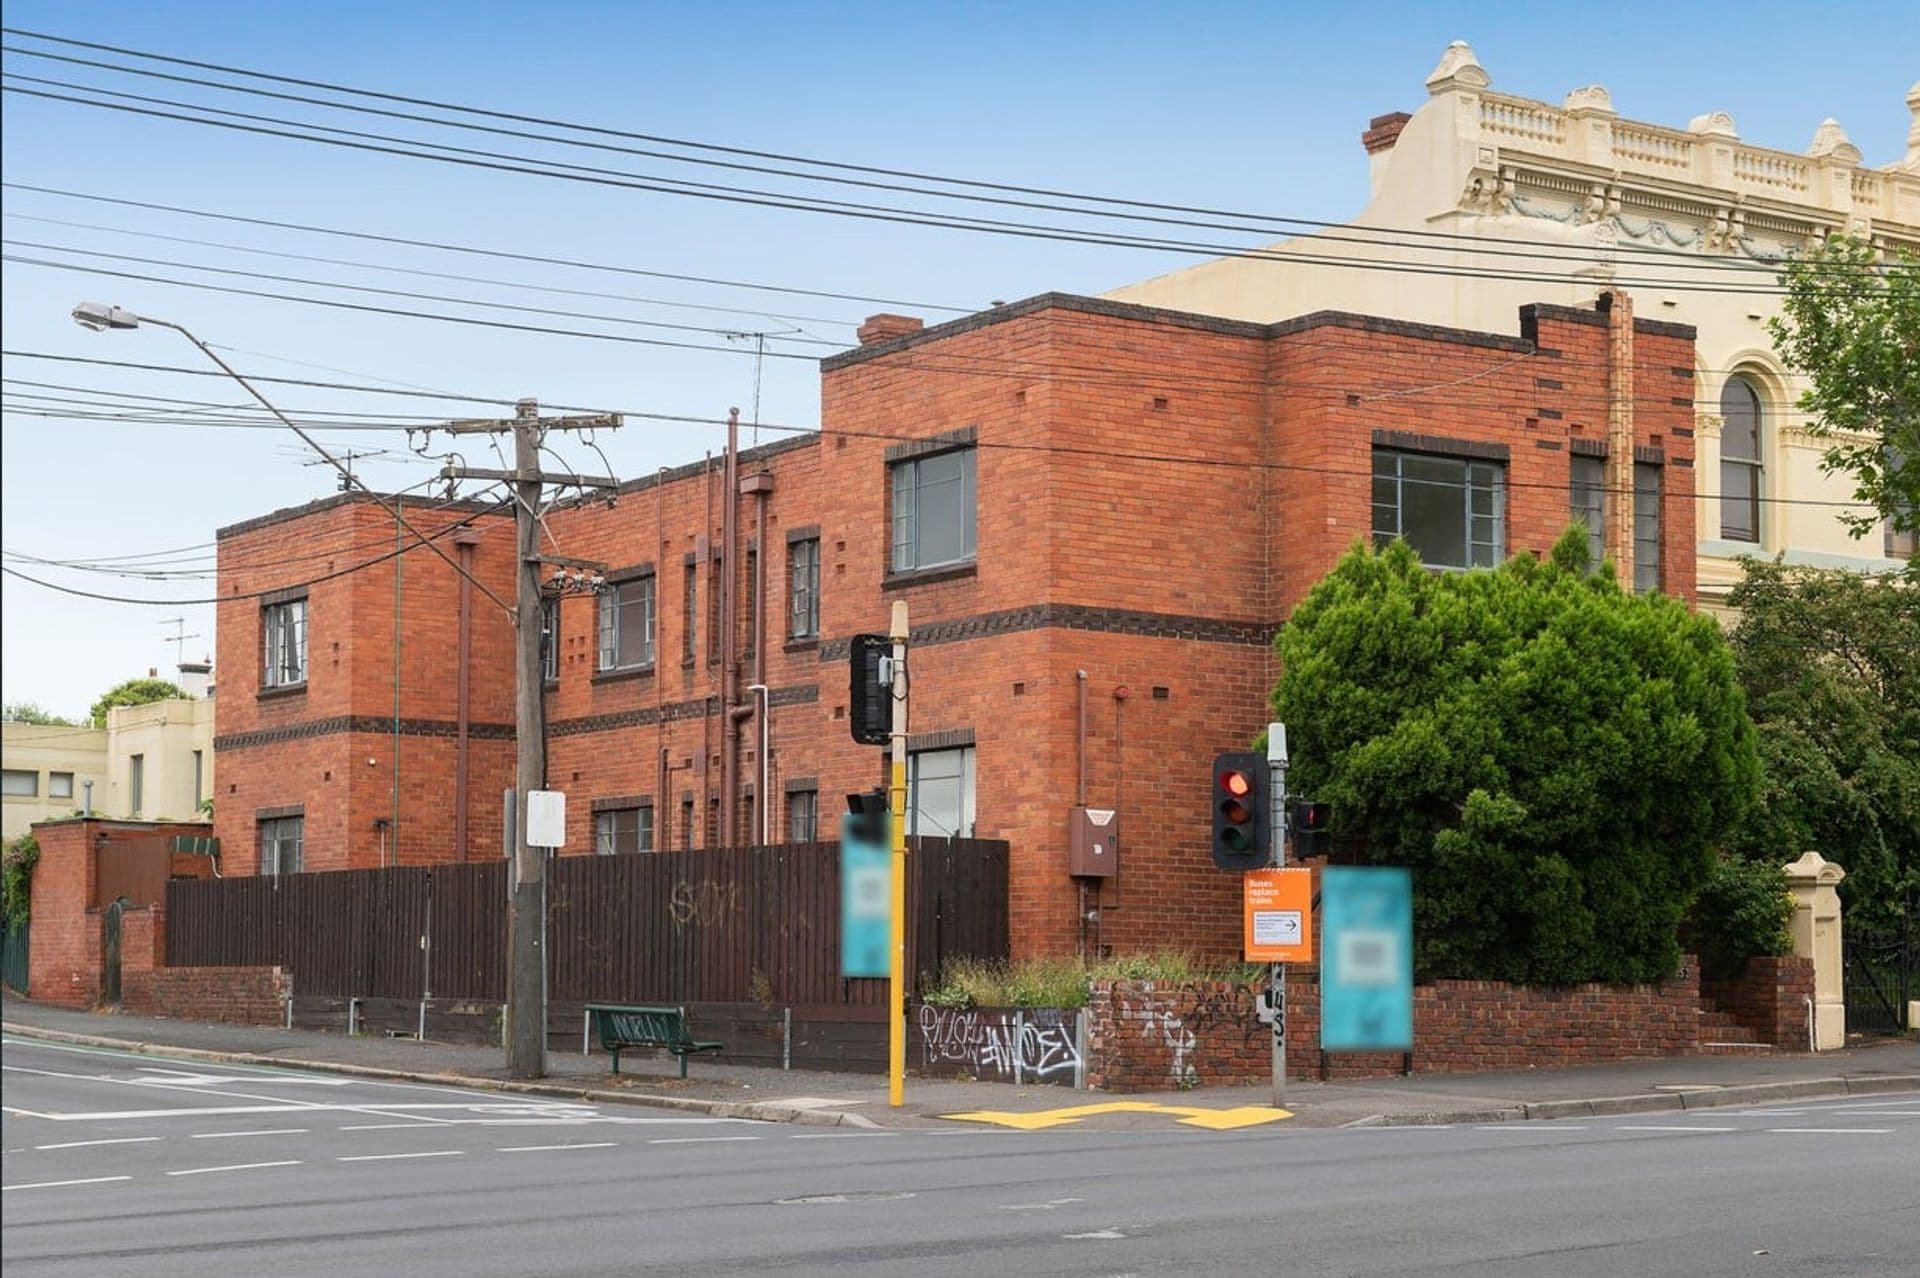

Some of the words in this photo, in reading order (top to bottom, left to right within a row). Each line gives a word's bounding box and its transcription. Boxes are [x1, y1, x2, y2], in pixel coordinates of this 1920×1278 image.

[1248, 880, 1273, 888] Buses
[1248, 889, 1280, 898] replace
[1248, 897, 1273, 905] trains
